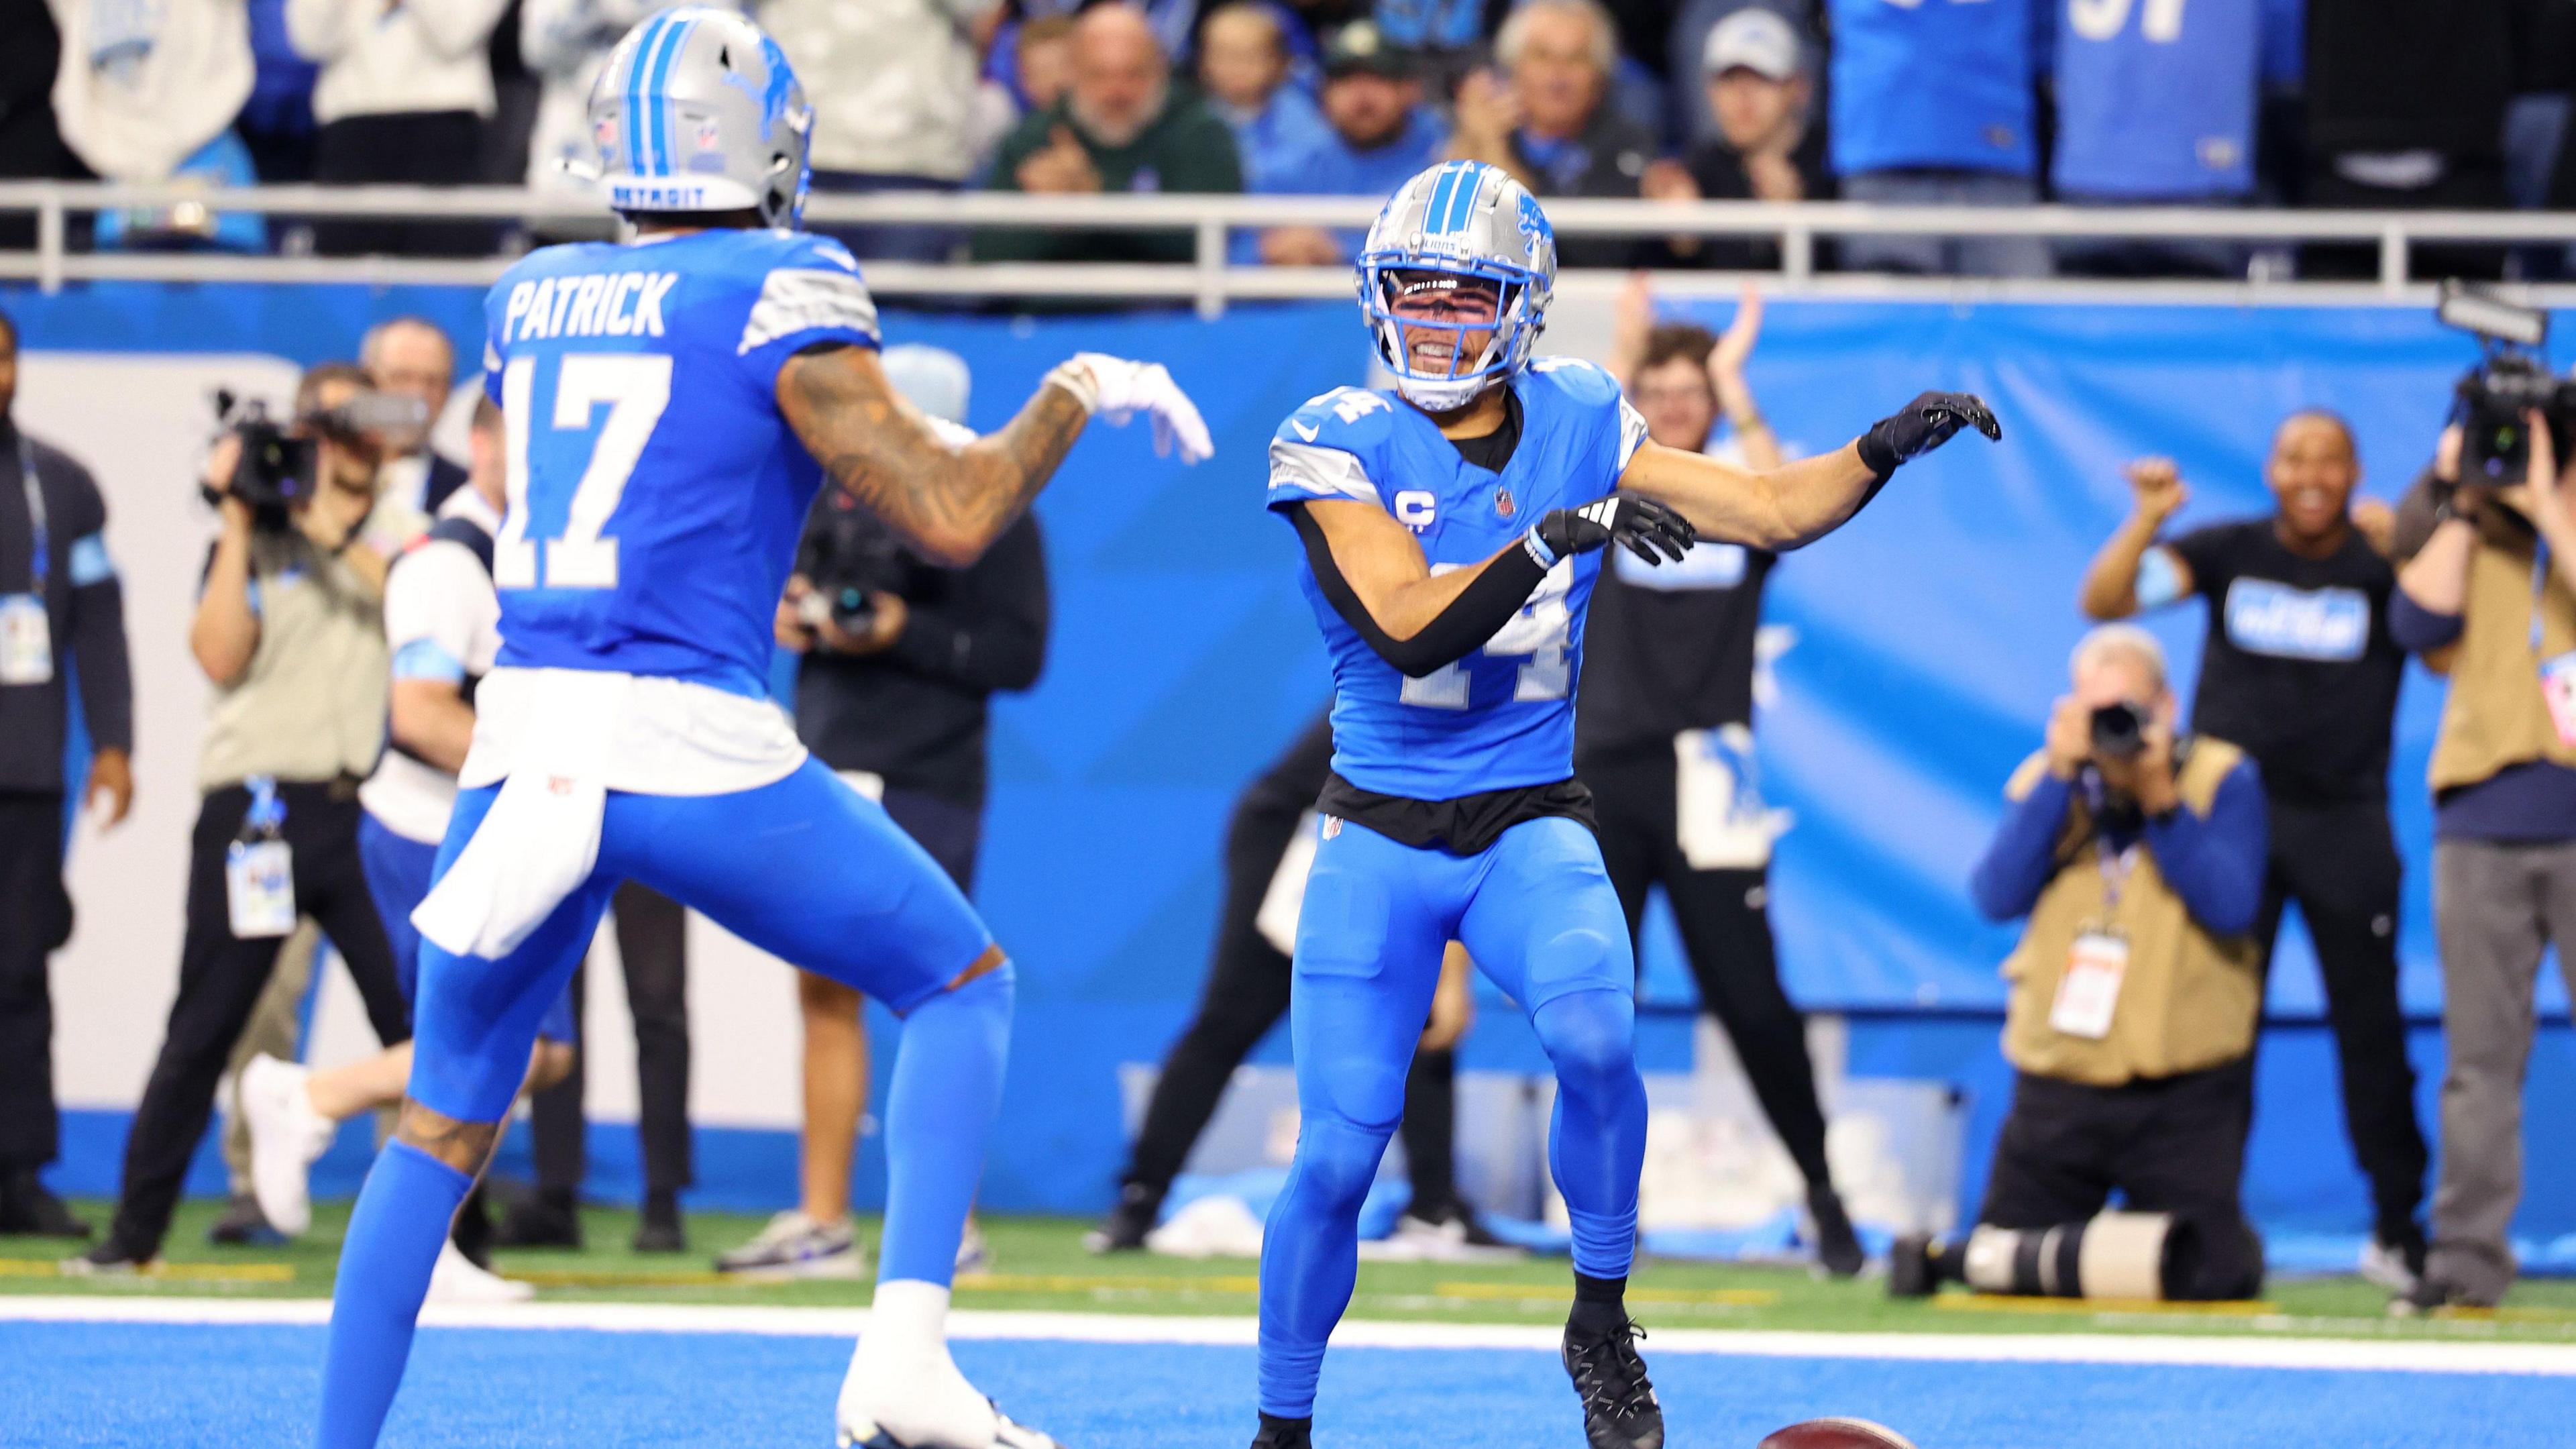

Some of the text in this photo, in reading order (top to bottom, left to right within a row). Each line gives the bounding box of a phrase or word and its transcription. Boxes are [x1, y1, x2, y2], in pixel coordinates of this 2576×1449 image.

[613, 185, 704, 205] DETROIT
[1424, 238, 1456, 251] LIONS
[502, 272, 679, 344] PATRICK
[493, 353, 673, 588] 17
[1395, 490, 1435, 526] C
